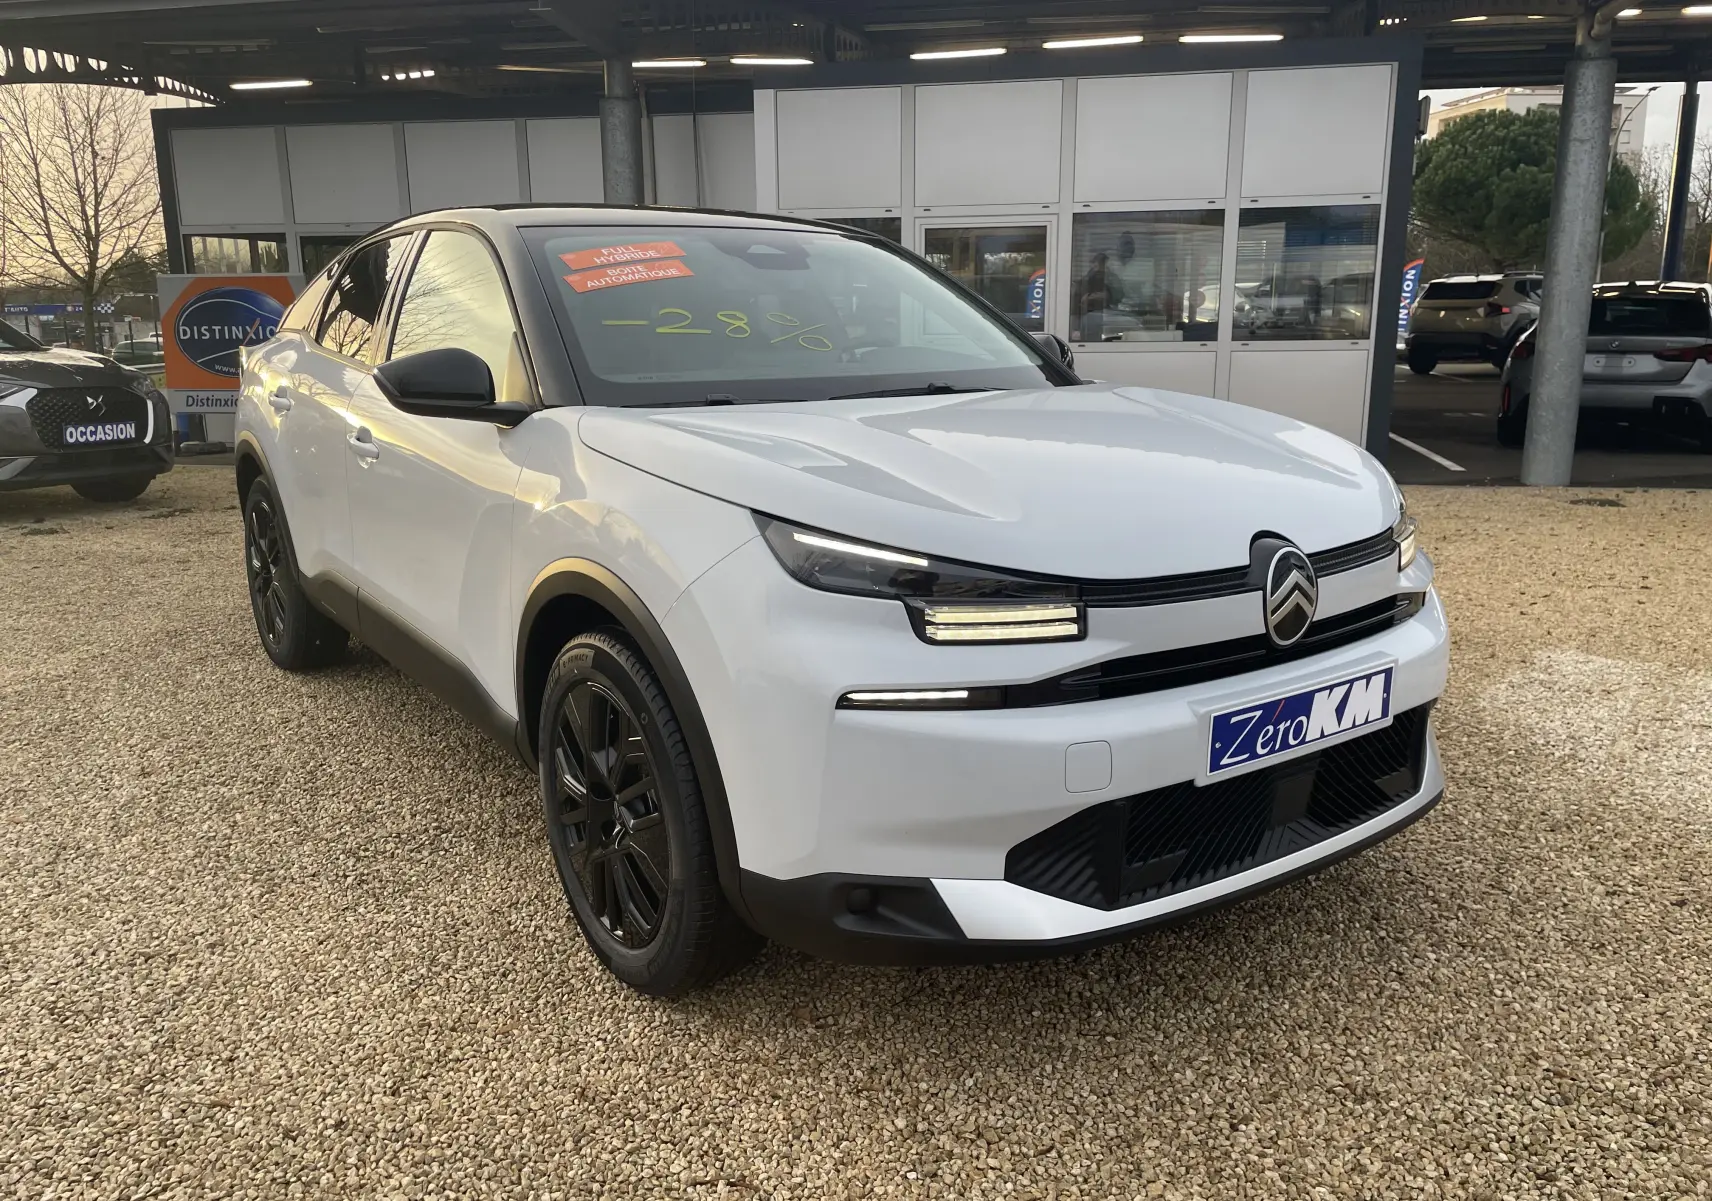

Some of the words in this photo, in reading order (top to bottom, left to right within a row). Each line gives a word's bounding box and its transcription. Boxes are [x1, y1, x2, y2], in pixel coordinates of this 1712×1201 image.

[593, 250, 661, 264] HYBRIDE
[601, 245, 641, 256] FULL
[587, 267, 682, 288] AUTOMATIQUE
[606, 264, 649, 277] BOITE
[66, 423, 136, 443] OCCASION
